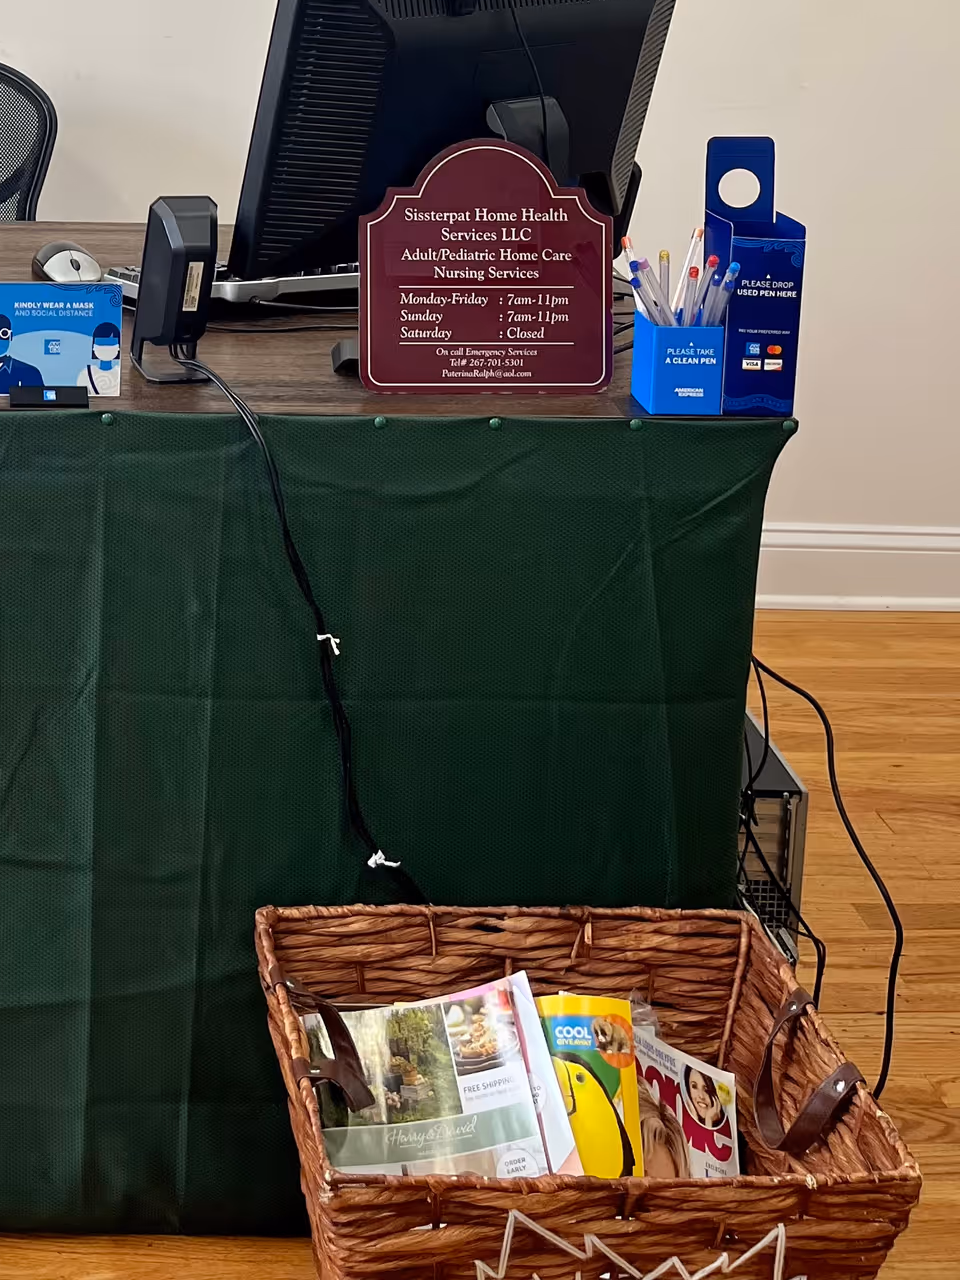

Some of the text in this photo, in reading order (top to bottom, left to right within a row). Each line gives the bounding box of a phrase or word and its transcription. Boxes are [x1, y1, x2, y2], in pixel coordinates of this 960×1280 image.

[404, 208, 568, 224] Sissterpat Home Health
[441, 228, 532, 241] Services LLC
[401, 249, 572, 262] Adult/Pediatric Home Care
[434, 266, 539, 281] Nursing Services
[742, 279, 794, 289] PLEASE DROP
[737, 288, 797, 298] USED PEN HERE
[399, 293, 569, 307] Monday-Friday 7am-11pm
[14, 302, 42, 310] KINDLY
[400, 310, 569, 324] Sunday 7am-11pm
[400, 326, 545, 340] Saturday Closed
[436, 347, 537, 357] On call Emergency Services
[667, 348, 715, 356] PLEASE TAKE
[449, 358, 524, 367] Tel# 267-701-5301
[672, 357, 699, 365] CLEAN
[700, 357, 716, 365] PEN
[442, 369, 532, 379] PaterinaRalph@aol.com
[555, 1026, 593, 1040] COOL
[463, 1085, 481, 1094] FREE
[504, 1157, 526, 1167] ORDER
[506, 1165, 527, 1175] EARLY
